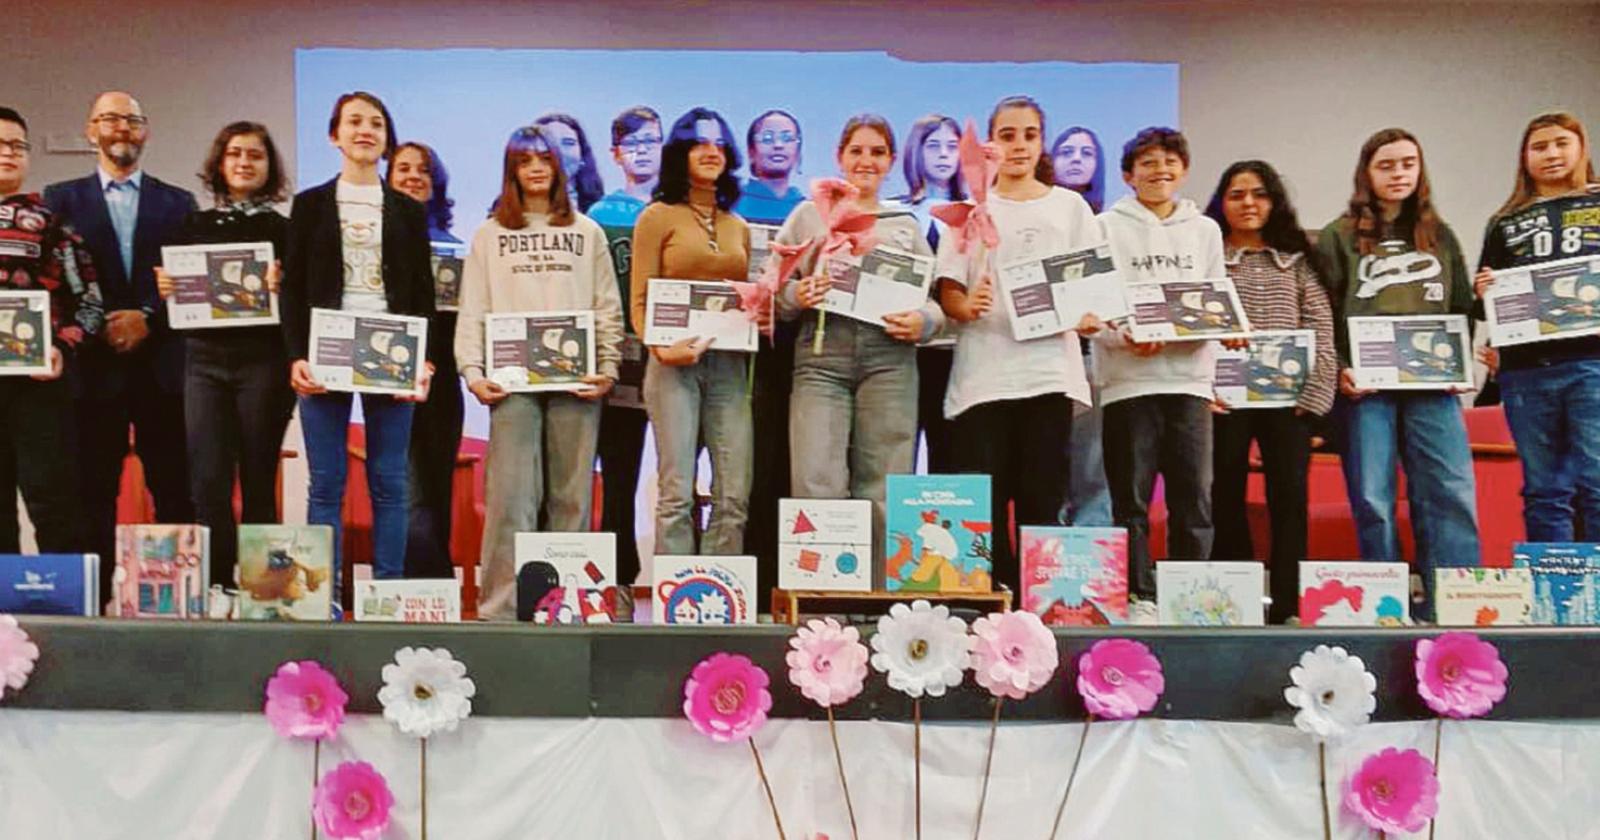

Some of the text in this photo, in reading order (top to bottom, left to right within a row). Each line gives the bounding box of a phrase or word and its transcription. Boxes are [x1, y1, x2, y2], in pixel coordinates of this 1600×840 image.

[498, 232, 585, 257] PORTLAND
[405, 598, 427, 609] CON
[404, 610, 447, 624] MANI
